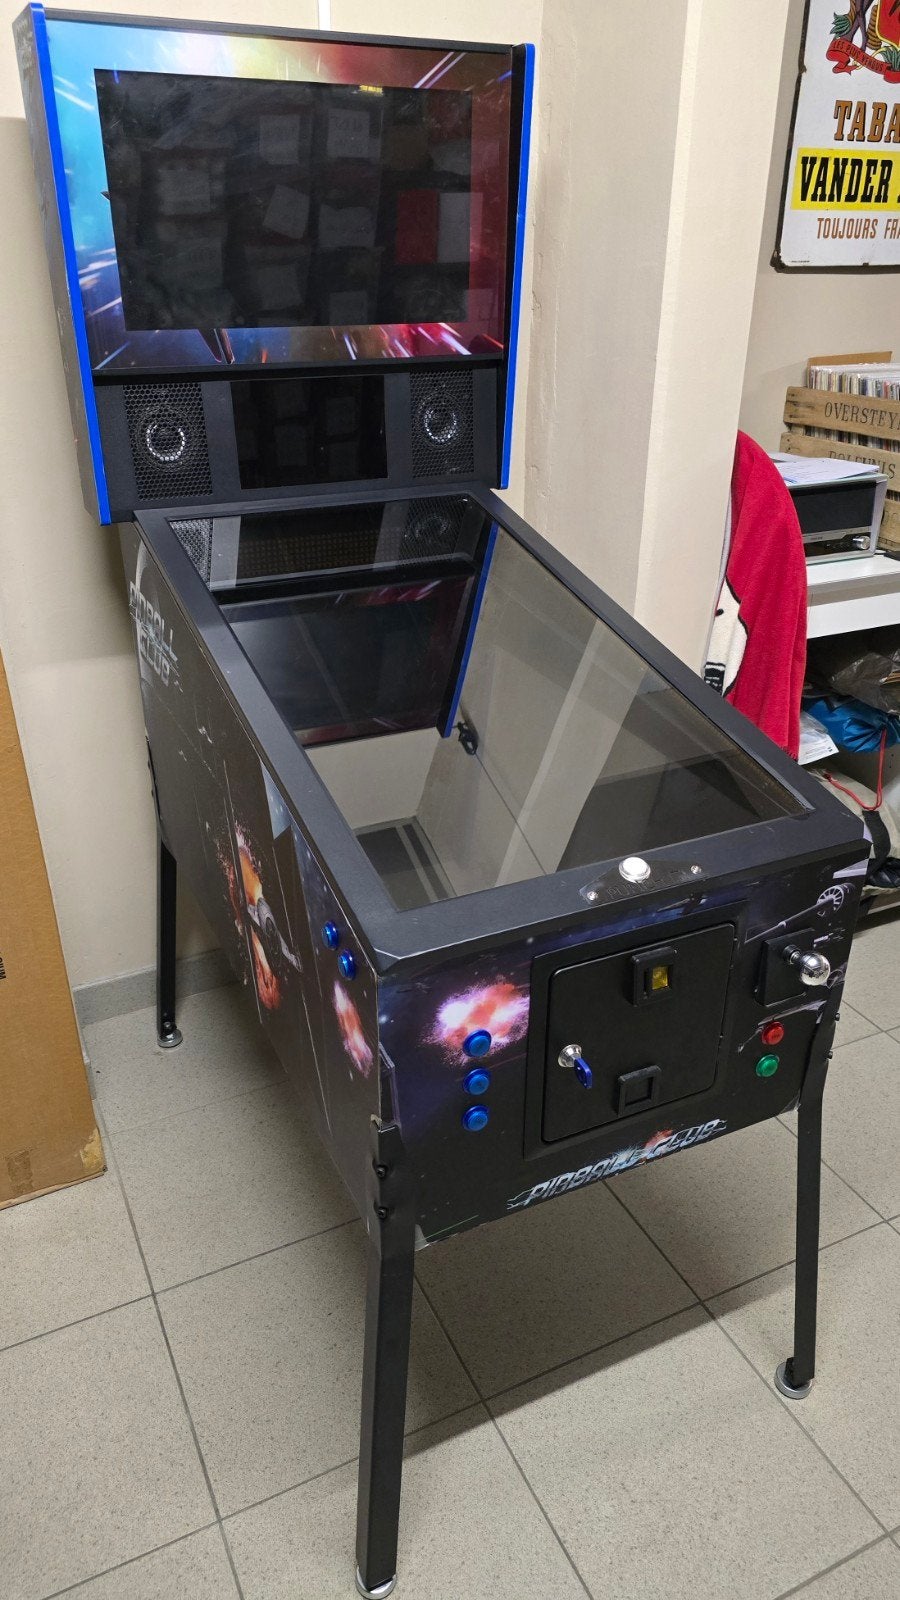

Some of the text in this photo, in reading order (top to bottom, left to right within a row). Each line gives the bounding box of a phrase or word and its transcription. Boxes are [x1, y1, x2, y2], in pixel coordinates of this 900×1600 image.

[833, 40, 844, 49] LES
[833, 99, 900, 143] TABA
[800, 156, 893, 204] VANDER
[817, 217, 878, 240] TOUJOURS
